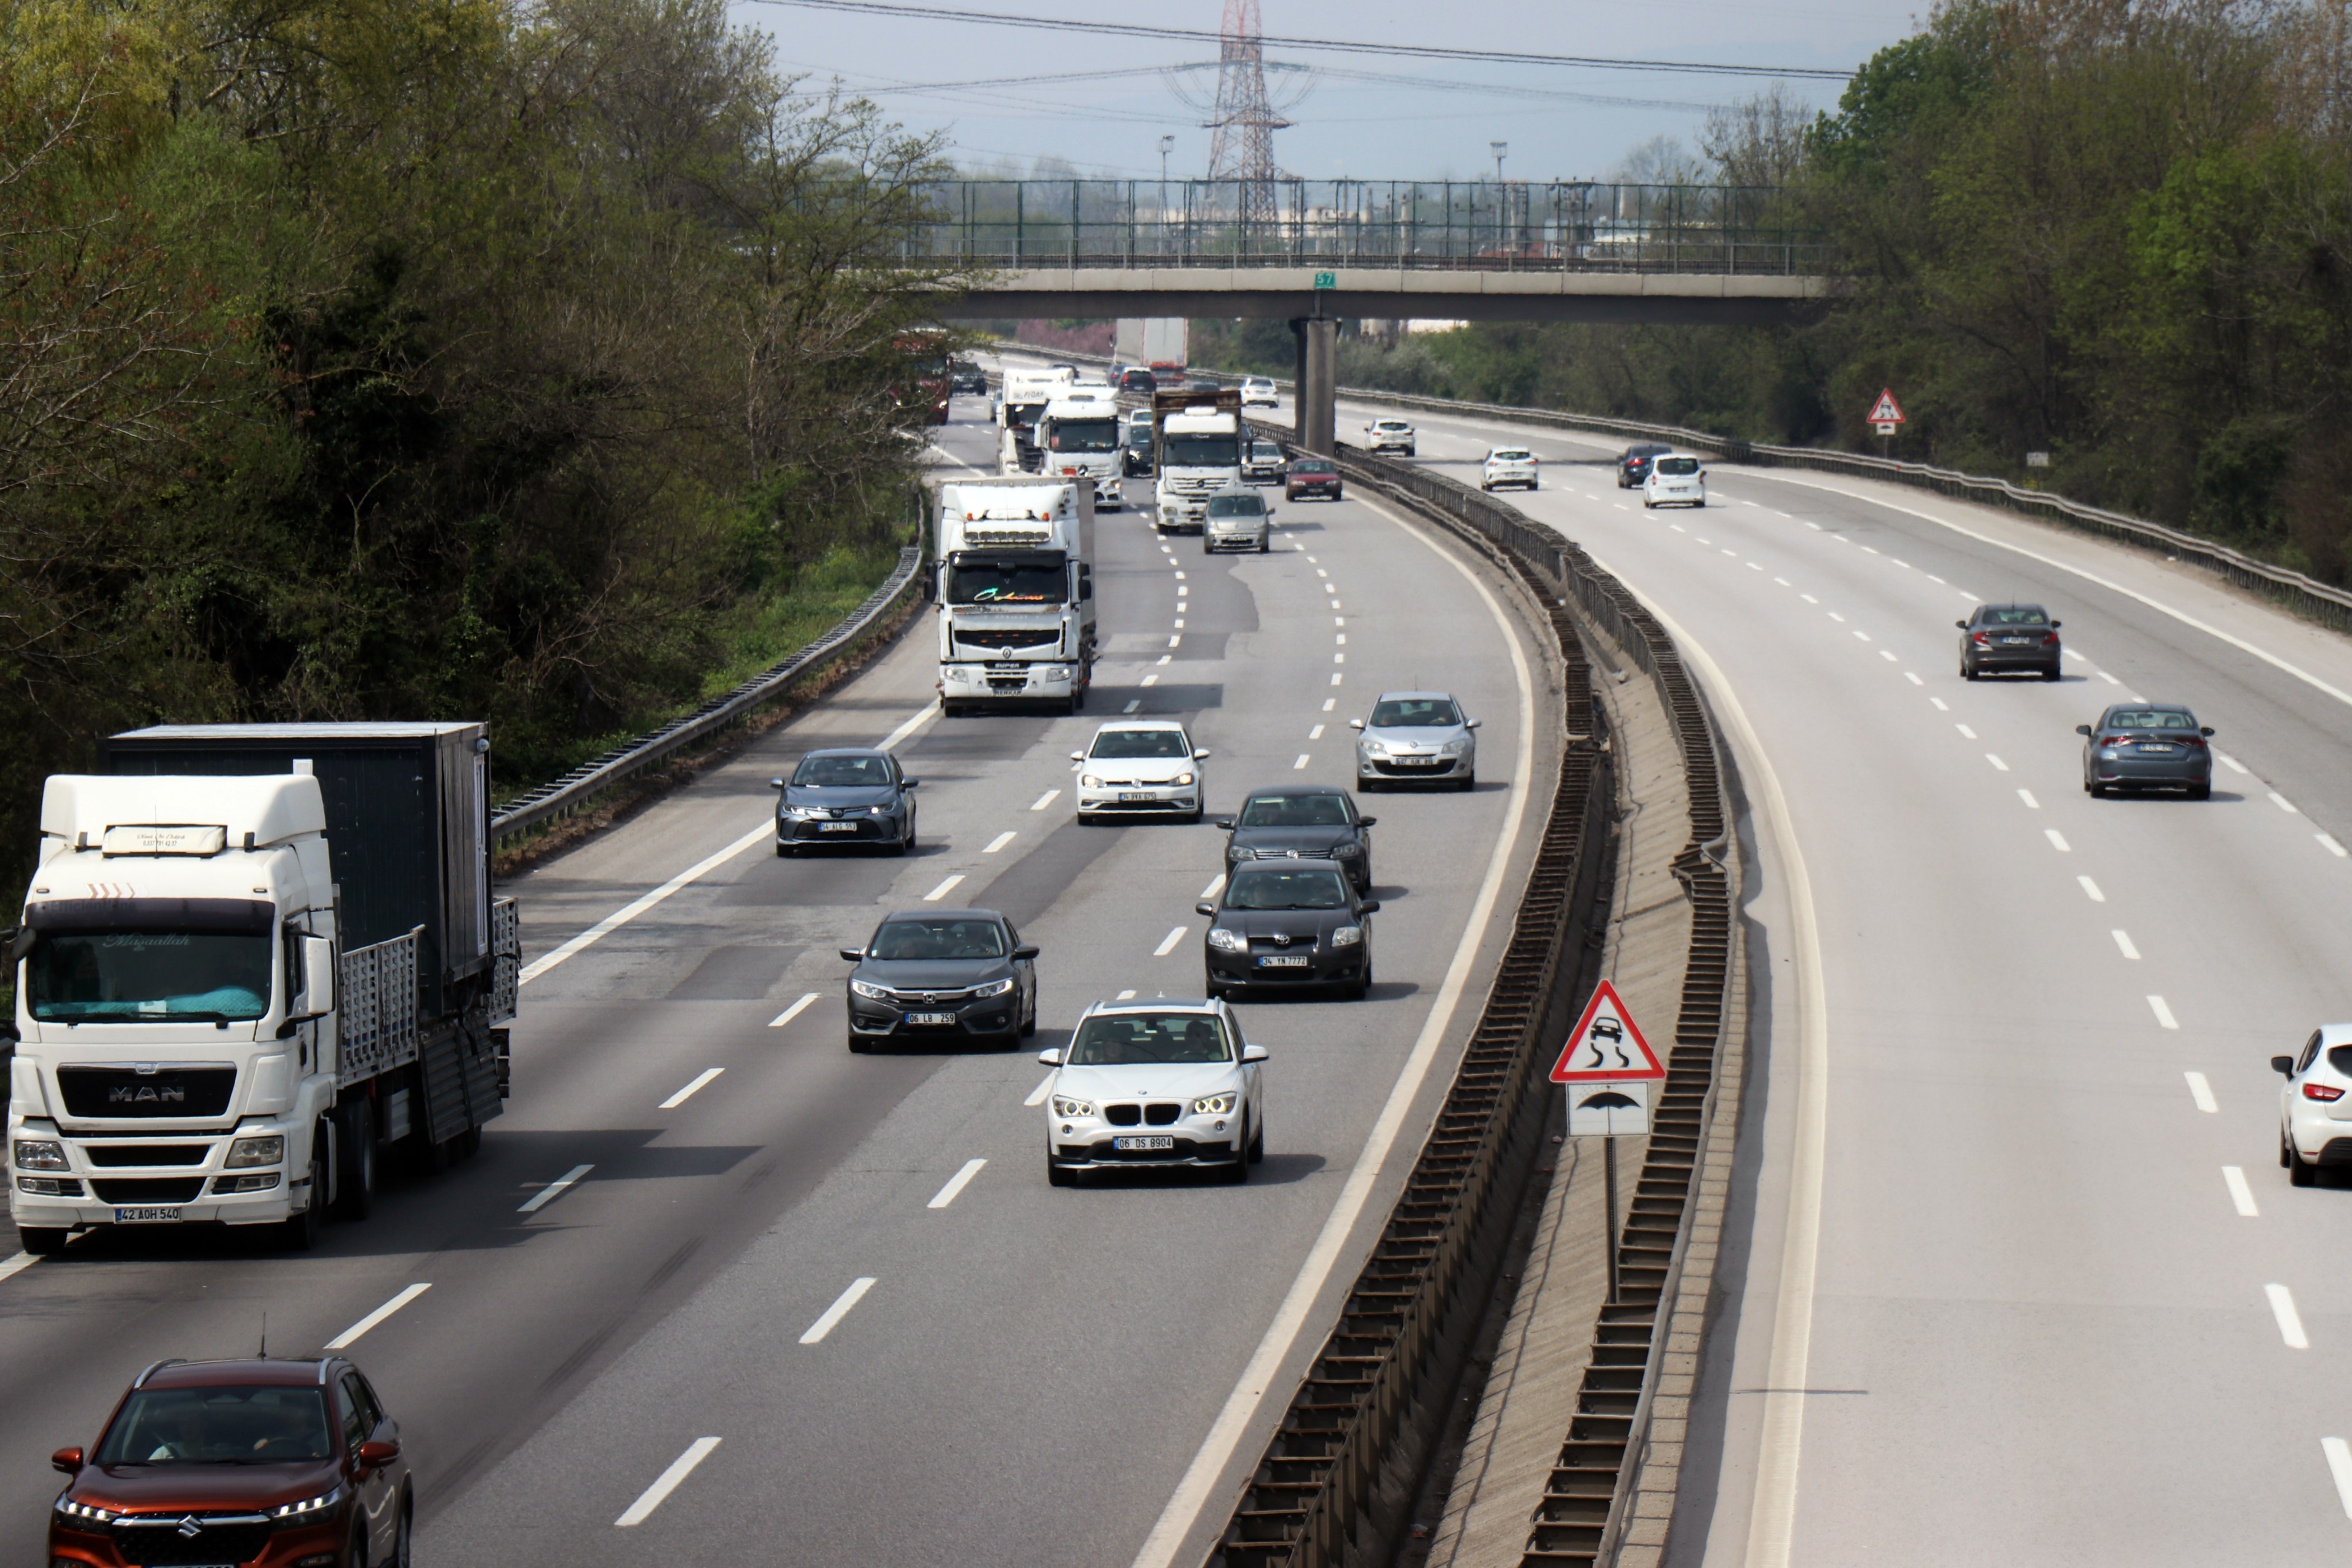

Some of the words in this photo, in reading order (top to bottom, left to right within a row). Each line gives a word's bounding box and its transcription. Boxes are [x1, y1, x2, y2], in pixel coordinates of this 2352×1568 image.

[1317, 273, 1332, 284] 57
[909, 1014, 918, 1023] 06
[923, 1014, 932, 1023] LB
[941, 1014, 954, 1023] 259
[109, 1086, 184, 1102] MAN
[1120, 1138, 1130, 1148] 06
[1136, 1138, 1146, 1148] DS
[1150, 1138, 1171, 1147] 8904
[122, 1210, 134, 1220] 42
[138, 1209, 157, 1219] AOH
[160, 1209, 179, 1219] 540
